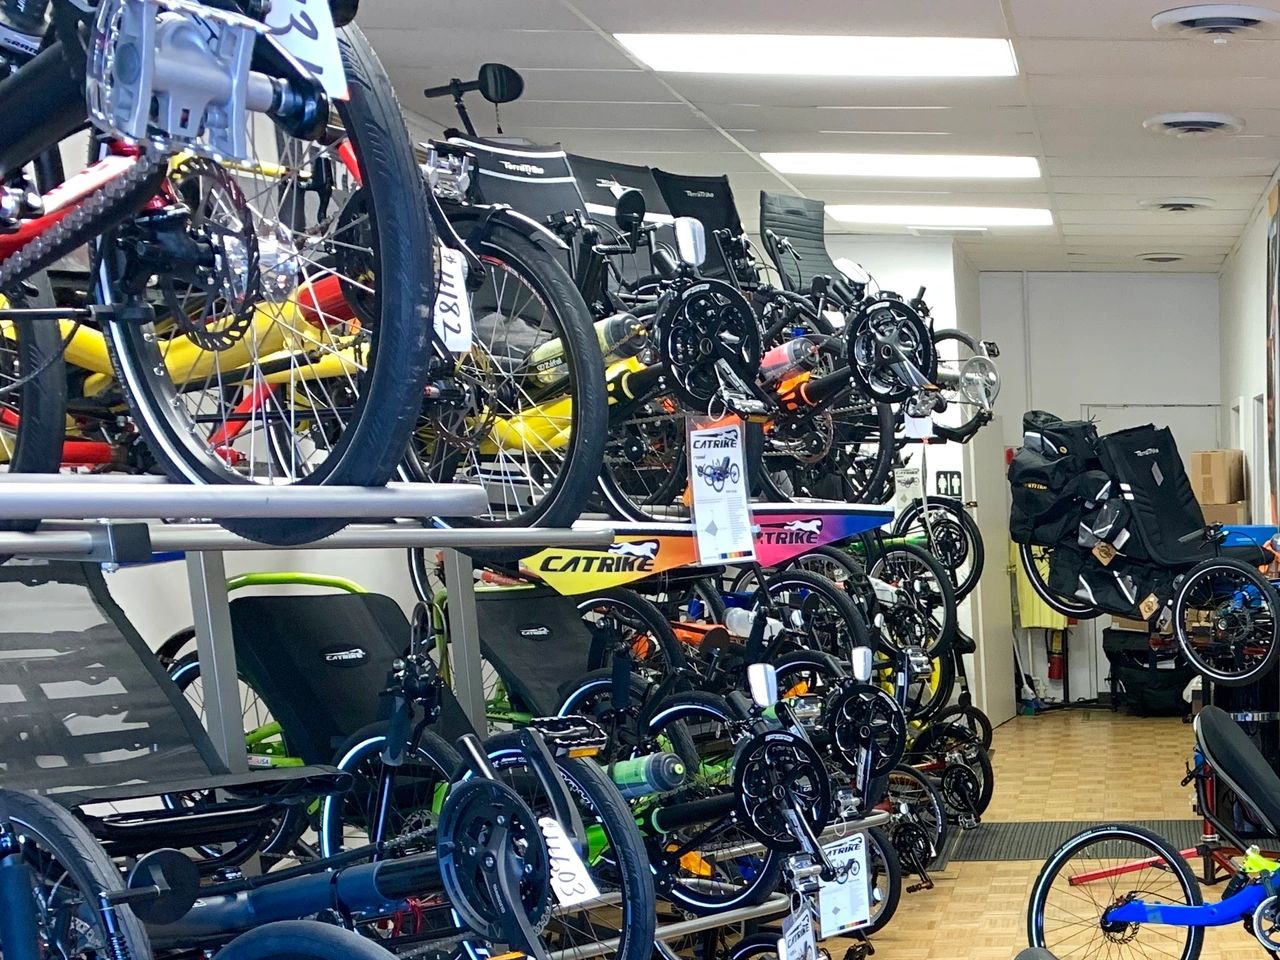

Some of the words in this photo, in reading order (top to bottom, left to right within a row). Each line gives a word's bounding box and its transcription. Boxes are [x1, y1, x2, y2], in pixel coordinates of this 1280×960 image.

[693, 438, 738, 449] CATRIKE
[760, 531, 820, 545] TRIKE
[540, 556, 656, 573] CATRIKE
[826, 844, 862, 857] ATRIKE
